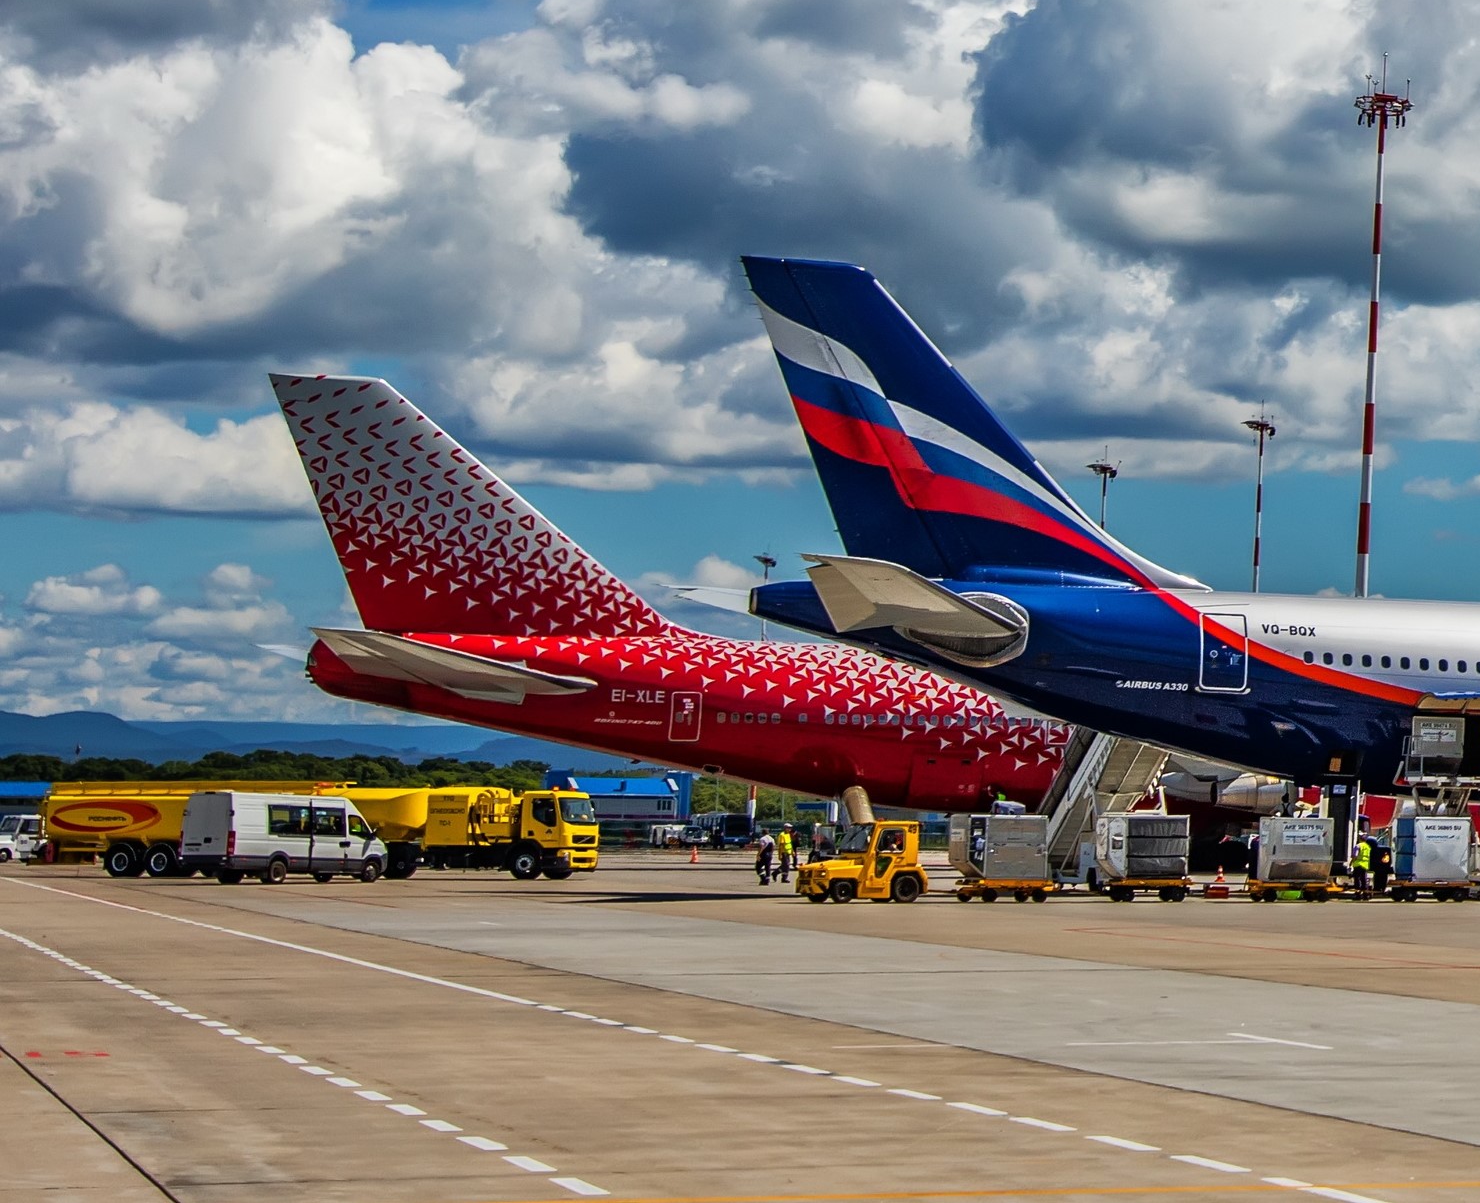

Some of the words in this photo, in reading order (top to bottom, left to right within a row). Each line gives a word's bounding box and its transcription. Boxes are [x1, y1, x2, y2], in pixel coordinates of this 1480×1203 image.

[1261, 623, 1316, 637] VQ-BQX
[1123, 680, 1162, 690] AIRBUS
[1162, 682, 1189, 692] A330
[611, 688, 666, 704] EI-XLE
